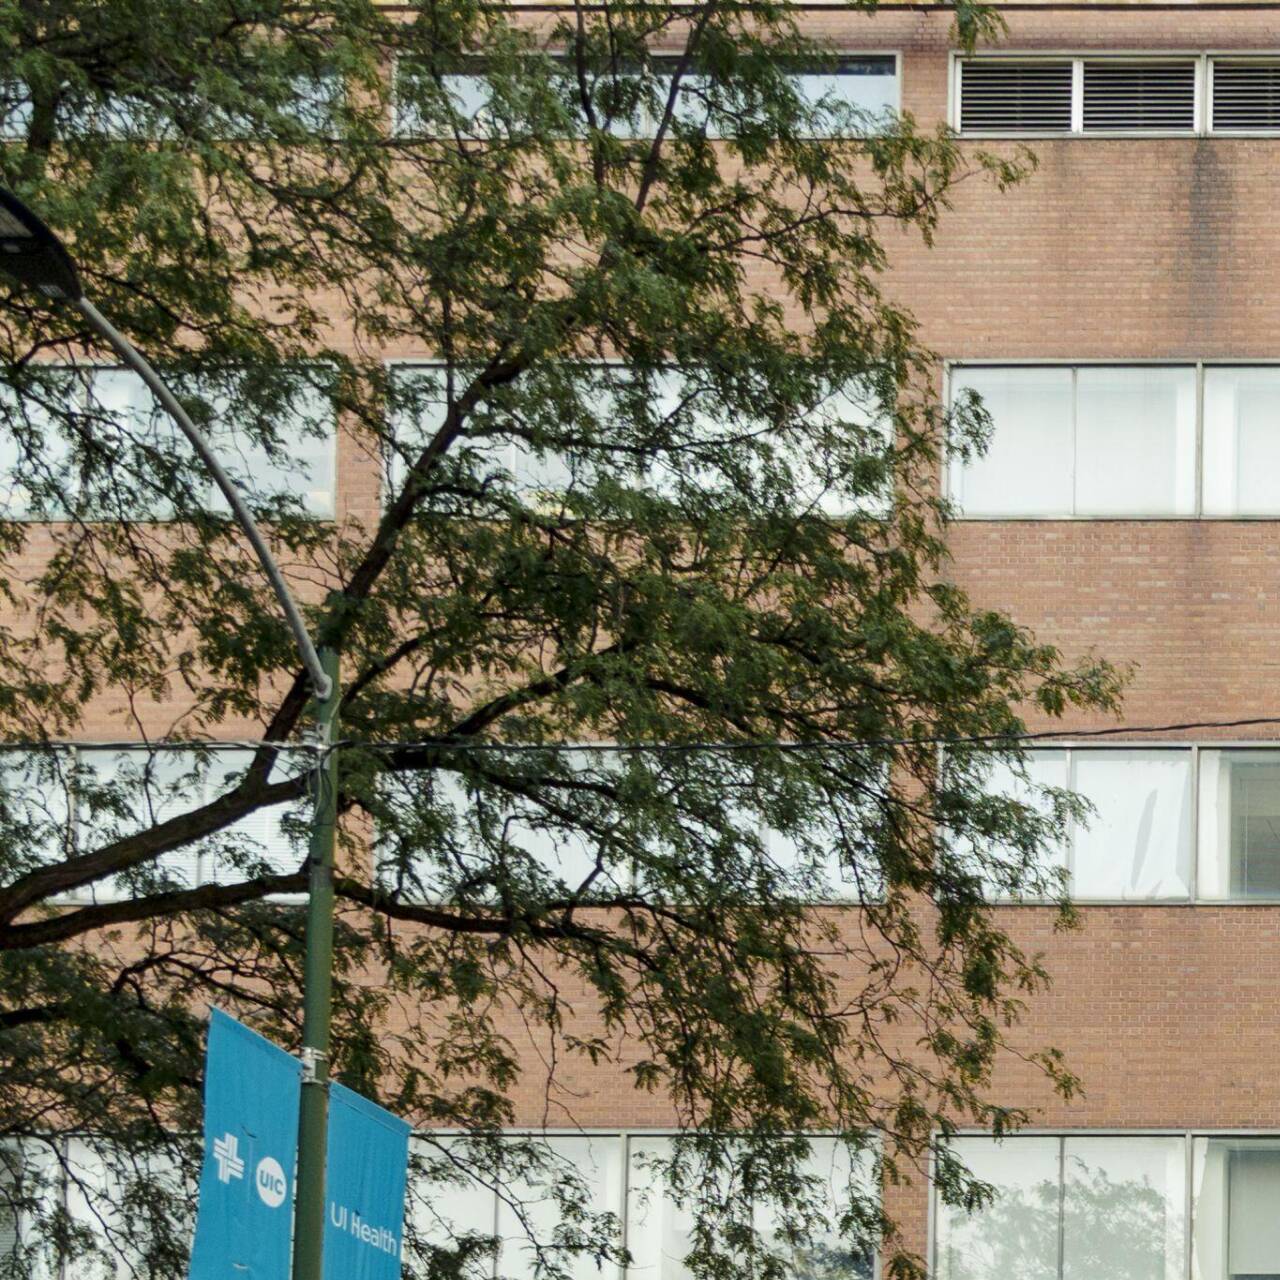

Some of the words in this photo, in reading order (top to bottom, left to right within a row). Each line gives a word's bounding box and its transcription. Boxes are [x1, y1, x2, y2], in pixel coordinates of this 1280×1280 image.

[258, 1169, 285, 1196] UIC
[330, 1201, 348, 1231] UI
[351, 1212, 398, 1257] Health
